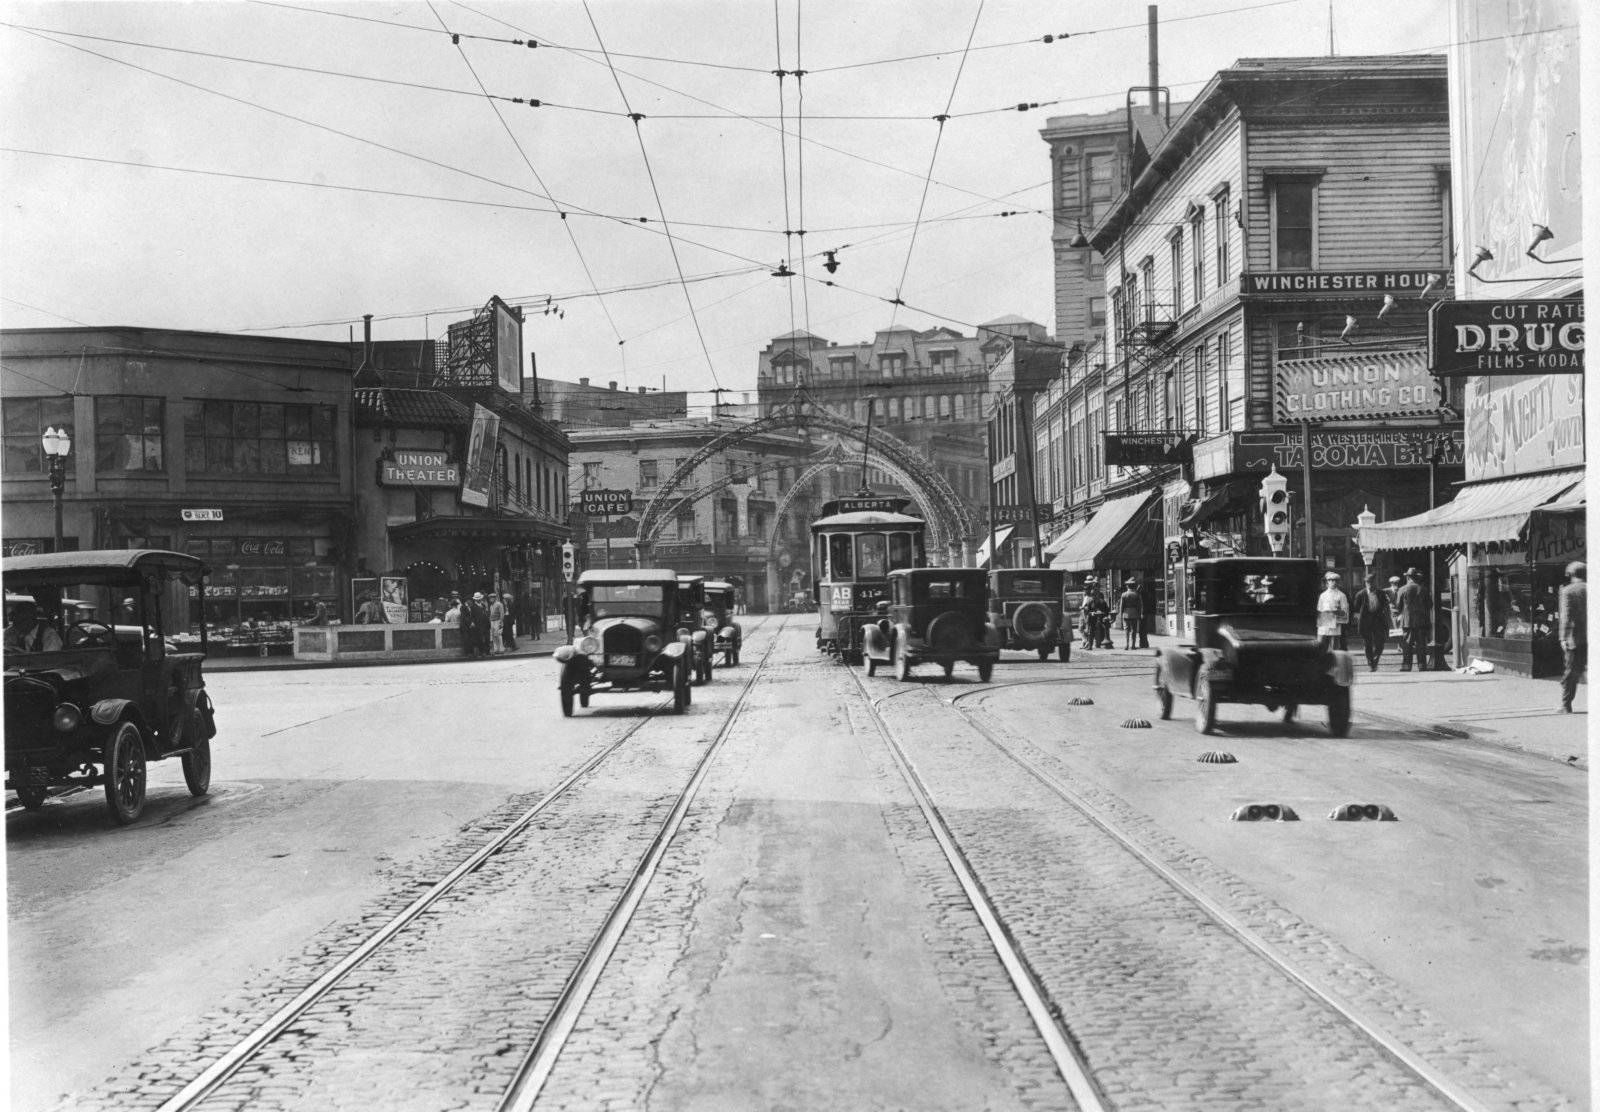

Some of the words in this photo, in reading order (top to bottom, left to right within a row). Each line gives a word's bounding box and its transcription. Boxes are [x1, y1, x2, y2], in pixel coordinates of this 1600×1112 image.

[1254, 275, 1378, 290] WINCHESTER
[1384, 273, 1456, 288] HOUE
[1491, 304, 1529, 320] CUT
[1537, 303, 1585, 319] RATE
[1478, 353, 1585, 369] FILMS-KODA
[1312, 362, 1400, 387] UNION
[1286, 387, 1392, 413] CLOTHING
[1398, 384, 1431, 405] CO.
[1120, 436, 1180, 446] WINCHESTE
[1286, 433, 1324, 447] HERY
[399, 454, 443, 467] UNION
[1274, 444, 1388, 468] TACOMA
[386, 466, 456, 482] THEATER
[584, 492, 628, 503] UNION
[844, 500, 892, 510] ALBERTA
[587, 502, 626, 513] CAFE
[628, 546, 691, 557] OFICE
[1169, 541, 1180, 563] EAT
[832, 586, 852, 600] AB
